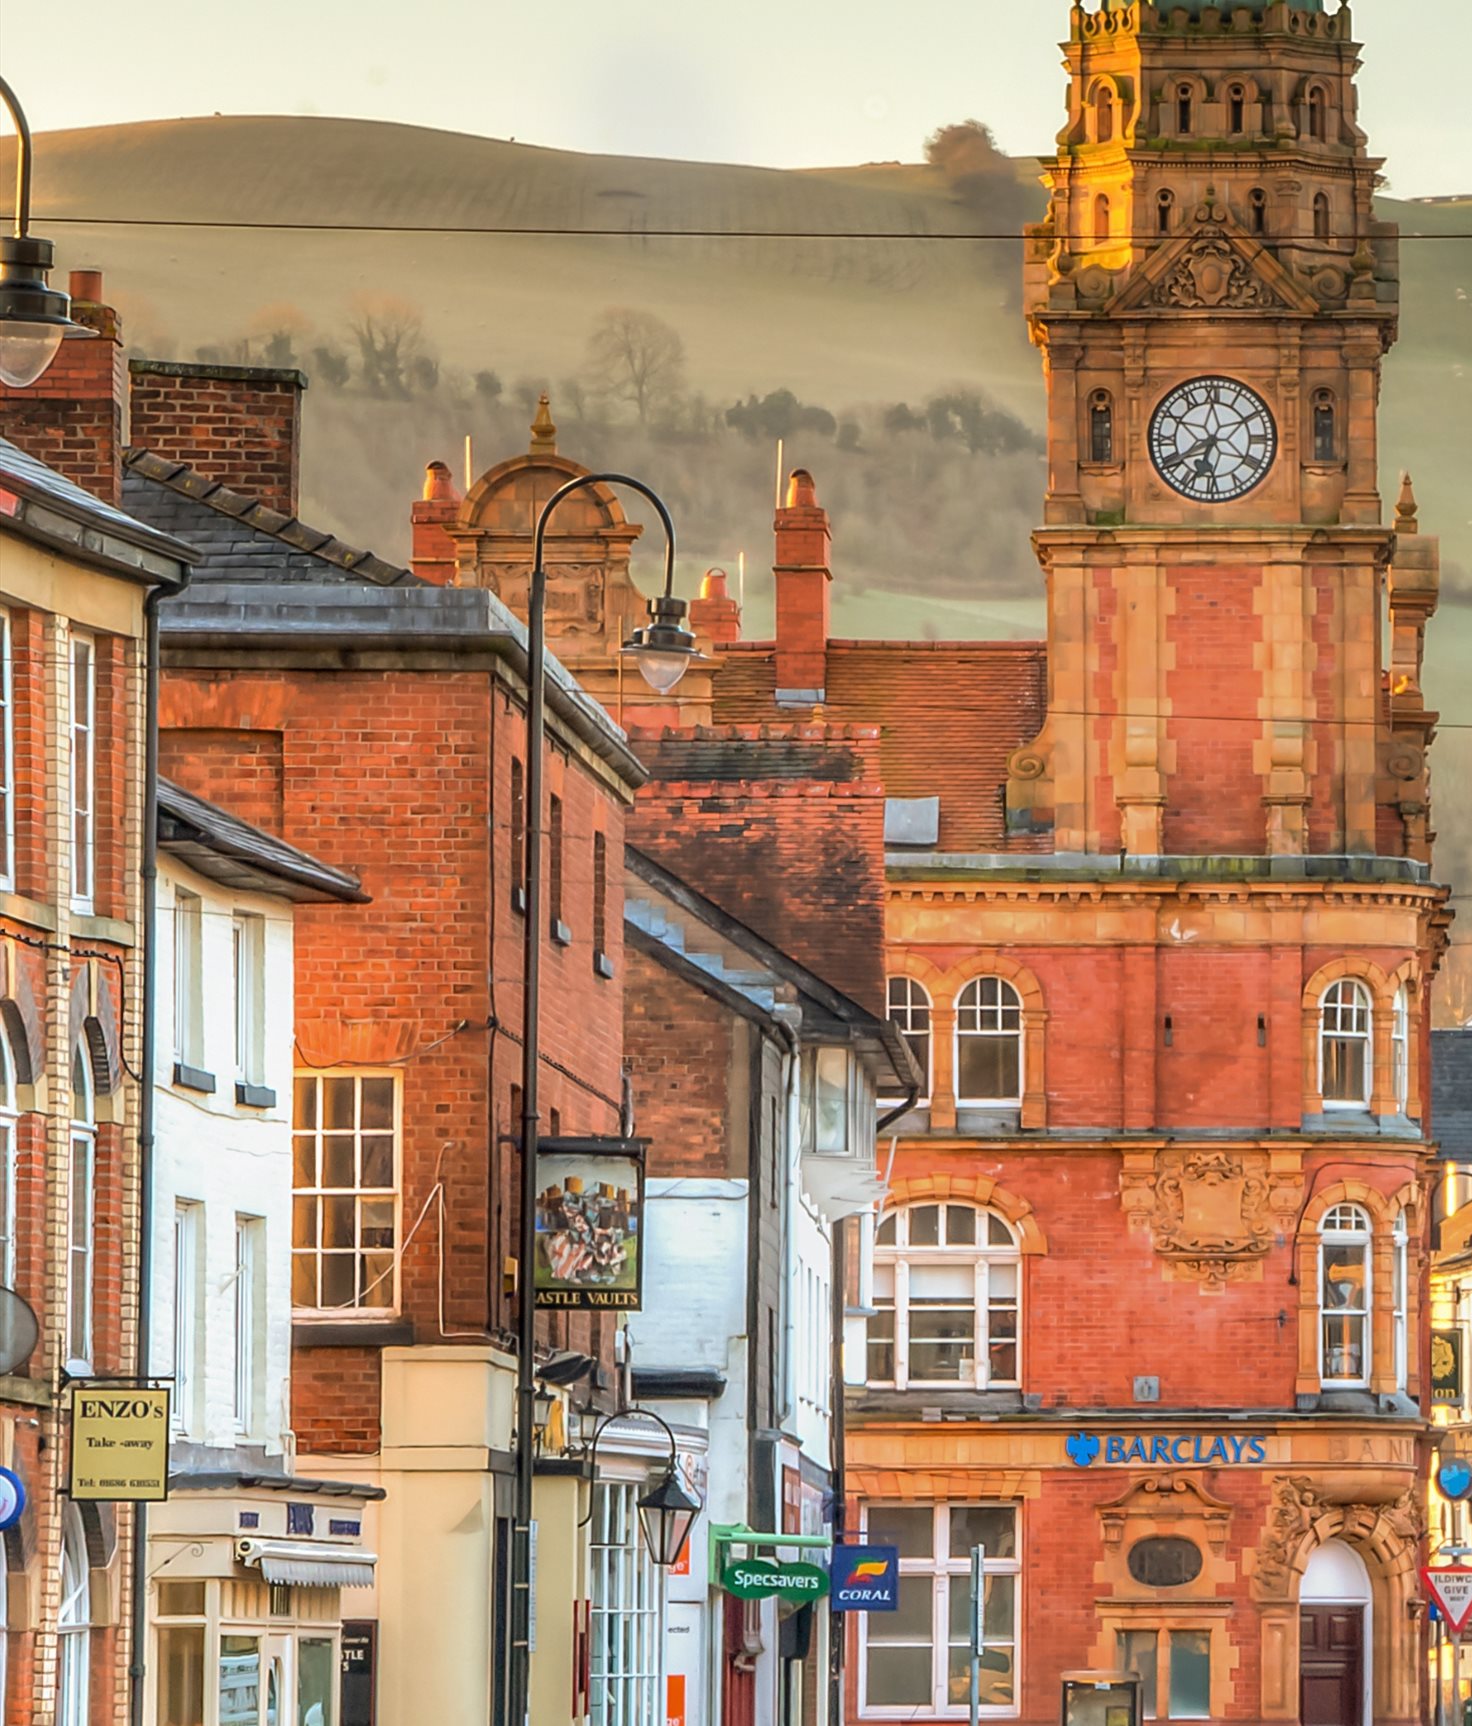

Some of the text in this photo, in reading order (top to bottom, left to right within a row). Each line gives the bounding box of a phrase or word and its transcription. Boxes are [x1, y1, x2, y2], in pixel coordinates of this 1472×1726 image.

[536, 1291, 638, 1305] ASTLE VAULTS
[1433, 1387, 1456, 1399] on
[80, 1400, 164, 1419] ENZO's
[86, 1437, 116, 1449] Take
[1105, 1435, 1267, 1464] BARCLAYS
[734, 1569, 819, 1589] Specsavers
[838, 1589, 891, 1601] CORAL
[1443, 1586, 1469, 1594] GIVE
